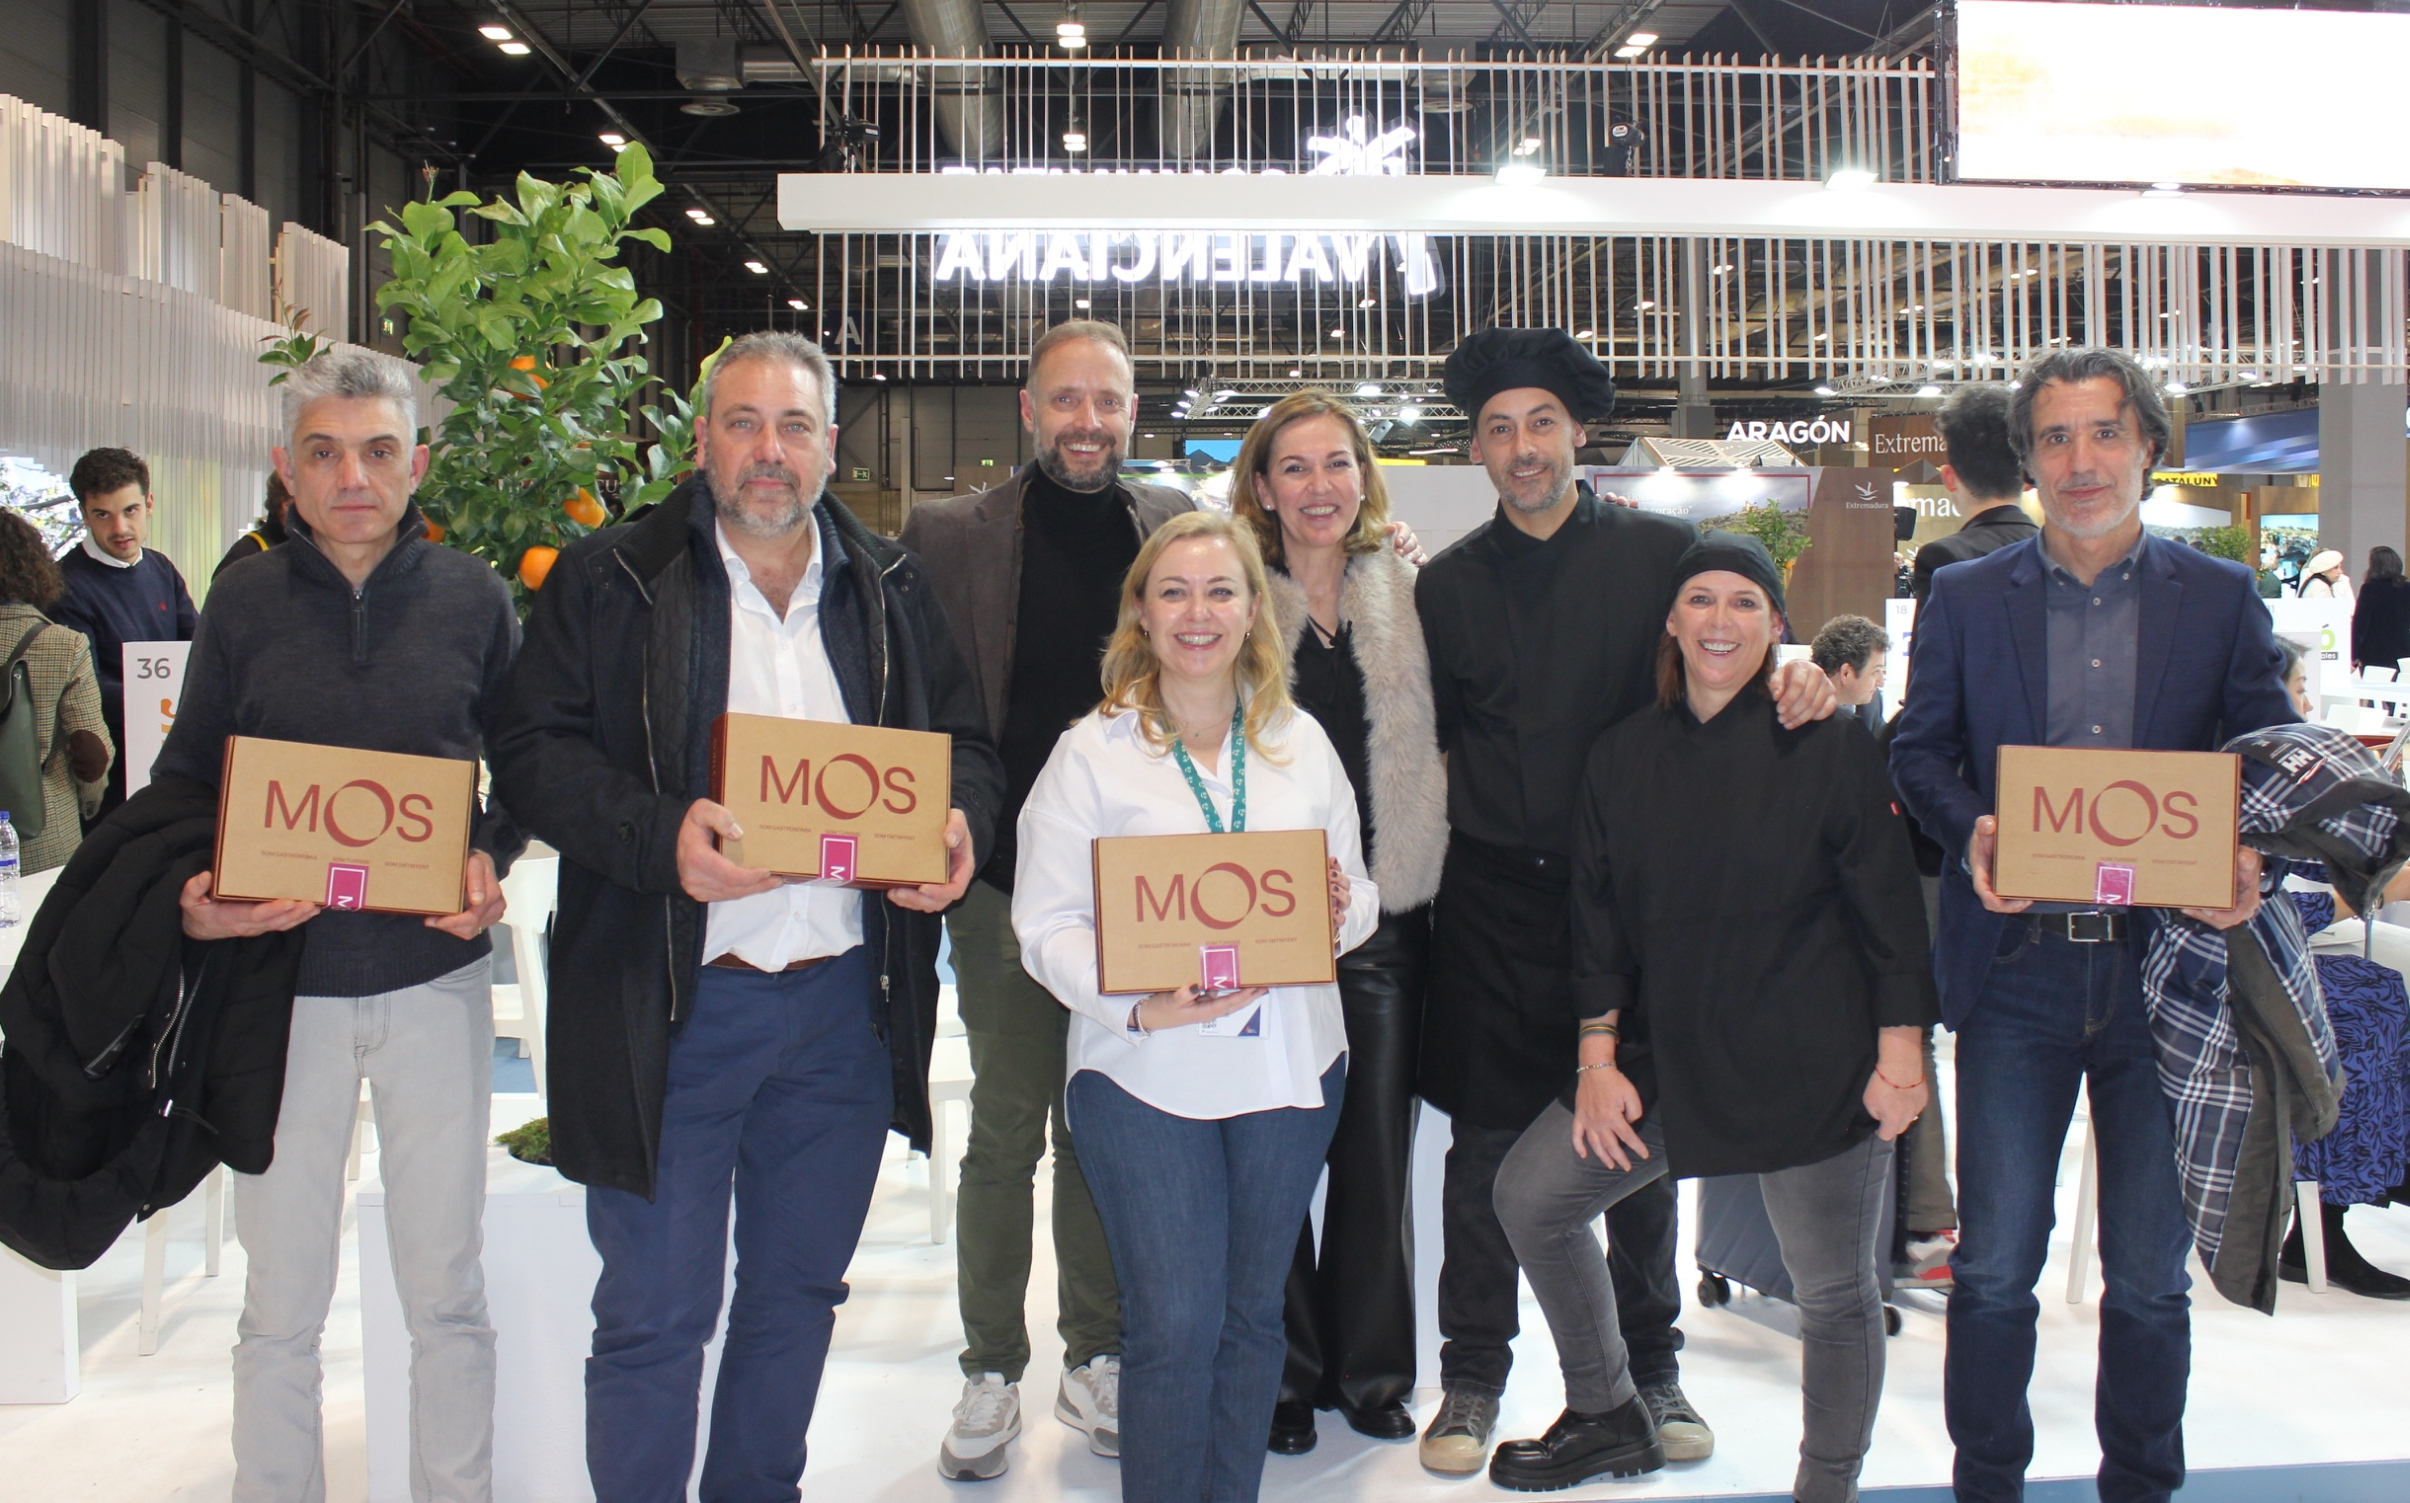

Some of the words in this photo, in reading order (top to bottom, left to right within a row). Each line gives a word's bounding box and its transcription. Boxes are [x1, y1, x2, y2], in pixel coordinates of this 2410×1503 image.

[1727, 415, 1850, 444] ARAGÓN
[1895, 605, 1908, 615] 18
[137, 658, 171, 679] 36
[264, 779, 433, 848] MOS
[760, 753, 917, 820] MOS
[2032, 780, 2199, 847] MOS
[1134, 862, 1296, 930] MOS
